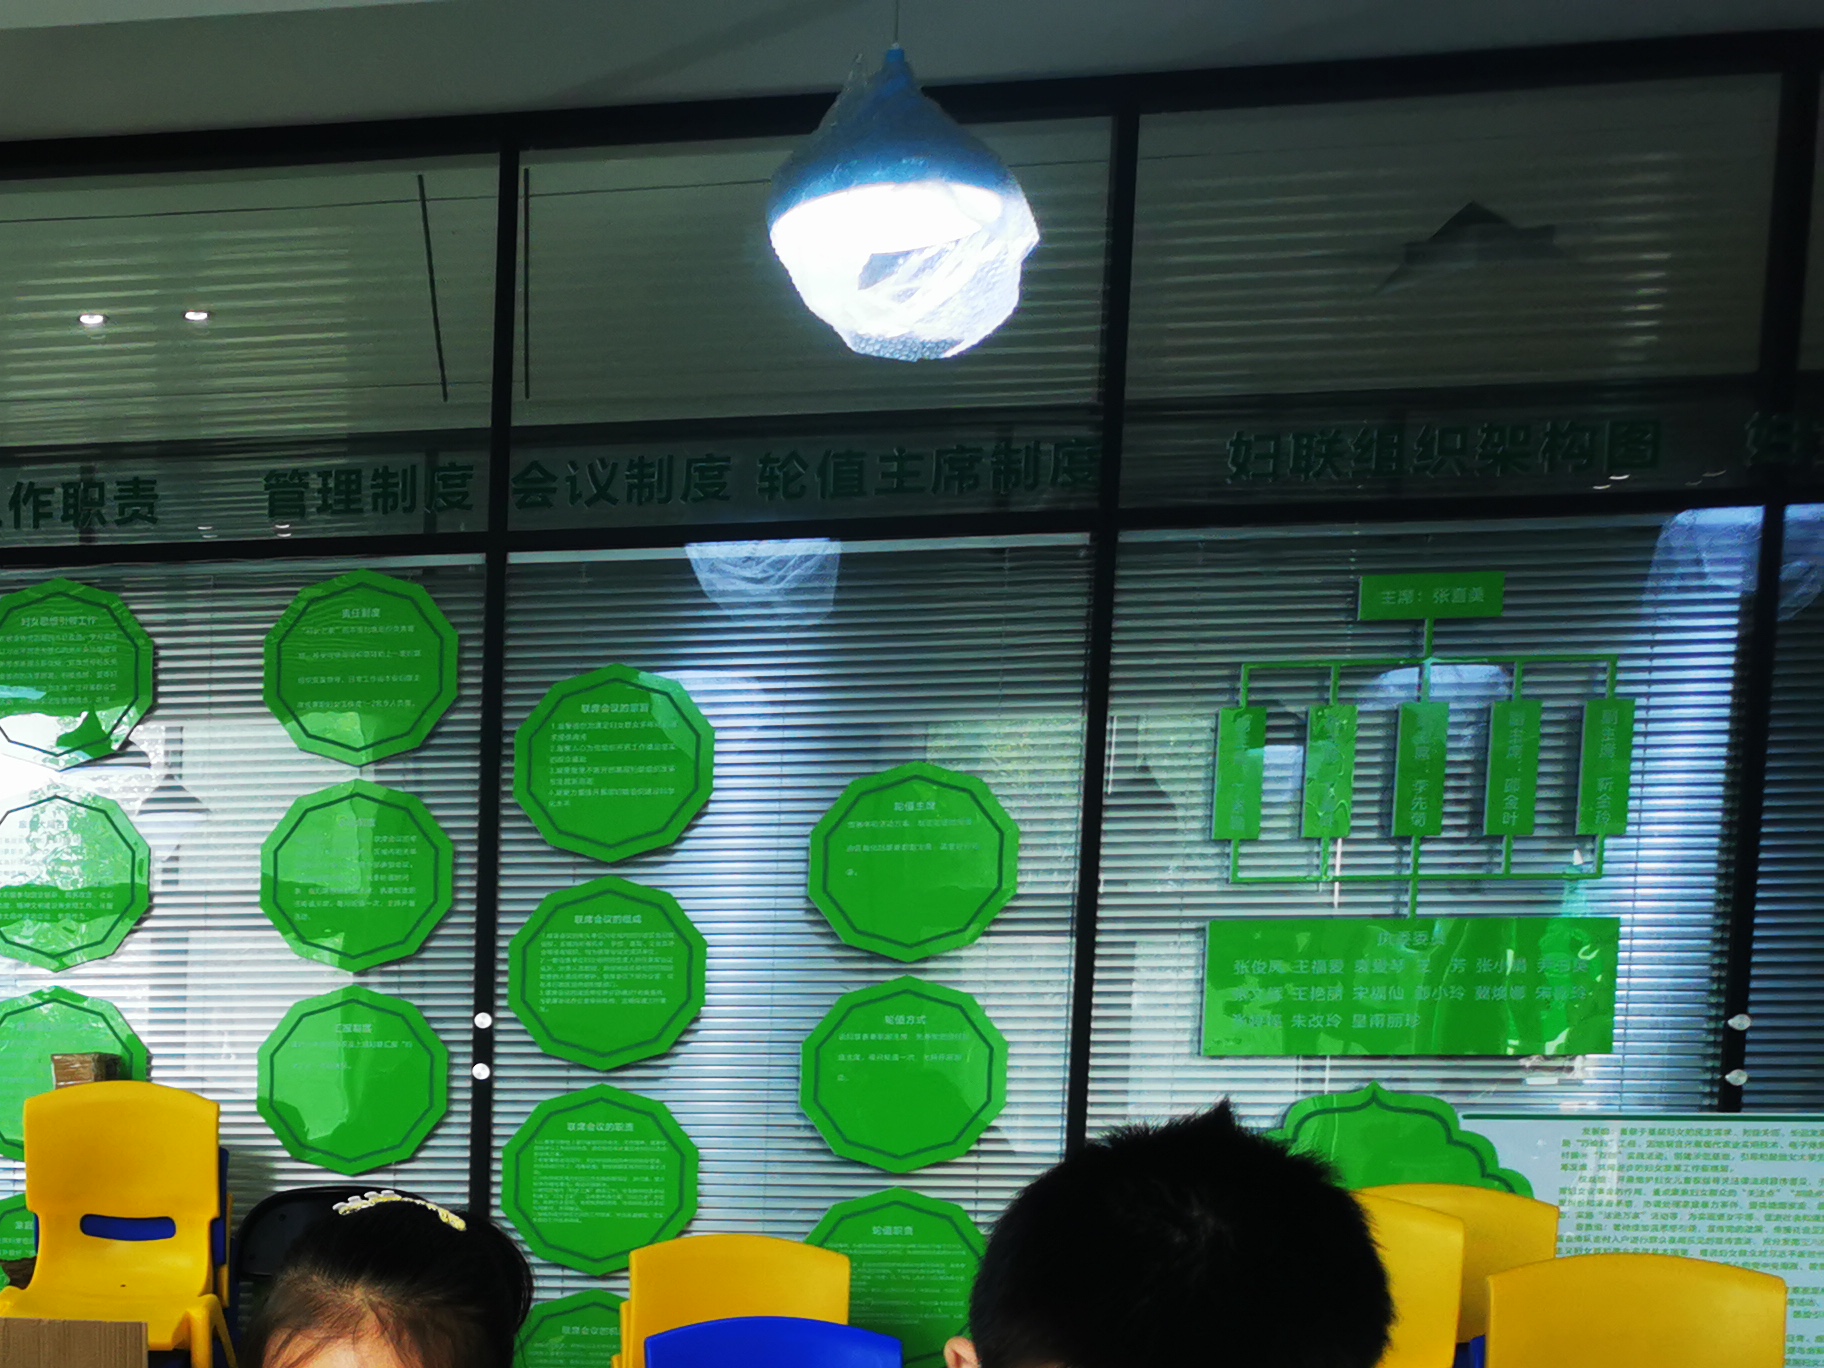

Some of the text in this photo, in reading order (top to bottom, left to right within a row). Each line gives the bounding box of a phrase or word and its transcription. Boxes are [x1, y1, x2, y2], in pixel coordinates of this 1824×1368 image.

[756, 440, 1101, 502] 轮值主席制度
[1226, 419, 1663, 484] 妇联组织架构图
[263, 462, 474, 521] 管理制度
[510, 453, 733, 511] 会议制度
